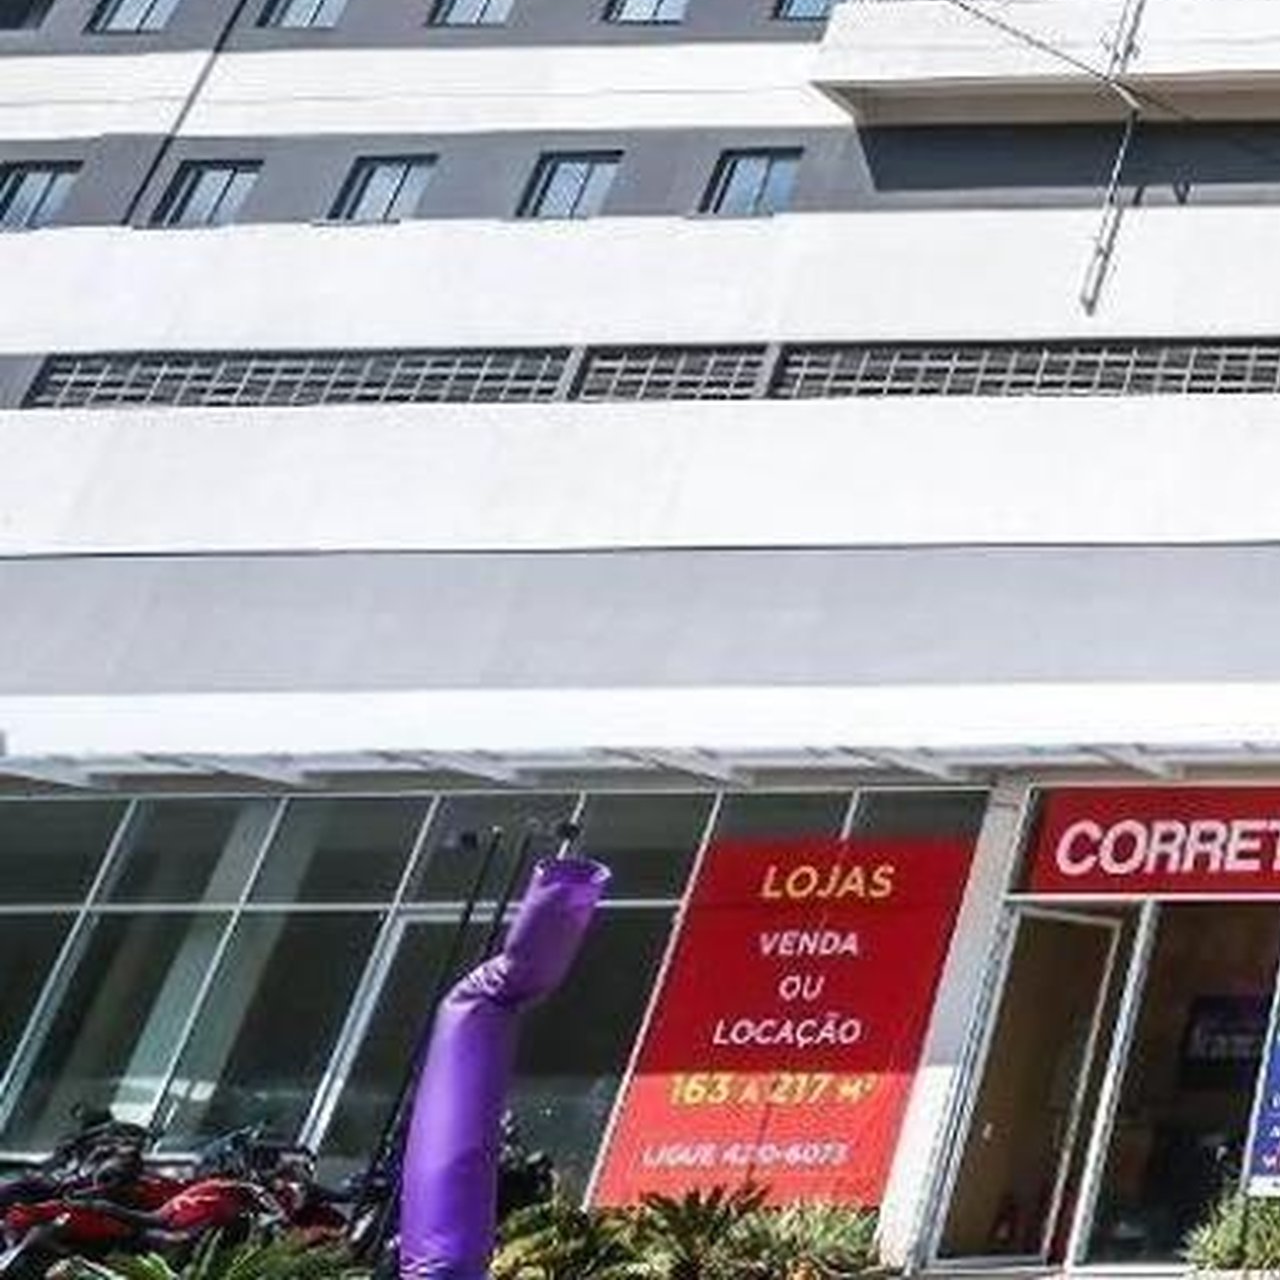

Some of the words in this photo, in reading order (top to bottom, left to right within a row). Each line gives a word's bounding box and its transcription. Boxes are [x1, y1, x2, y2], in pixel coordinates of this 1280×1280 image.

[760, 864, 896, 899] LOJAS
[758, 931, 860, 956] VENDA
[778, 976, 825, 1001] OU
[712, 1012, 862, 1048] LOCAÇÃO
